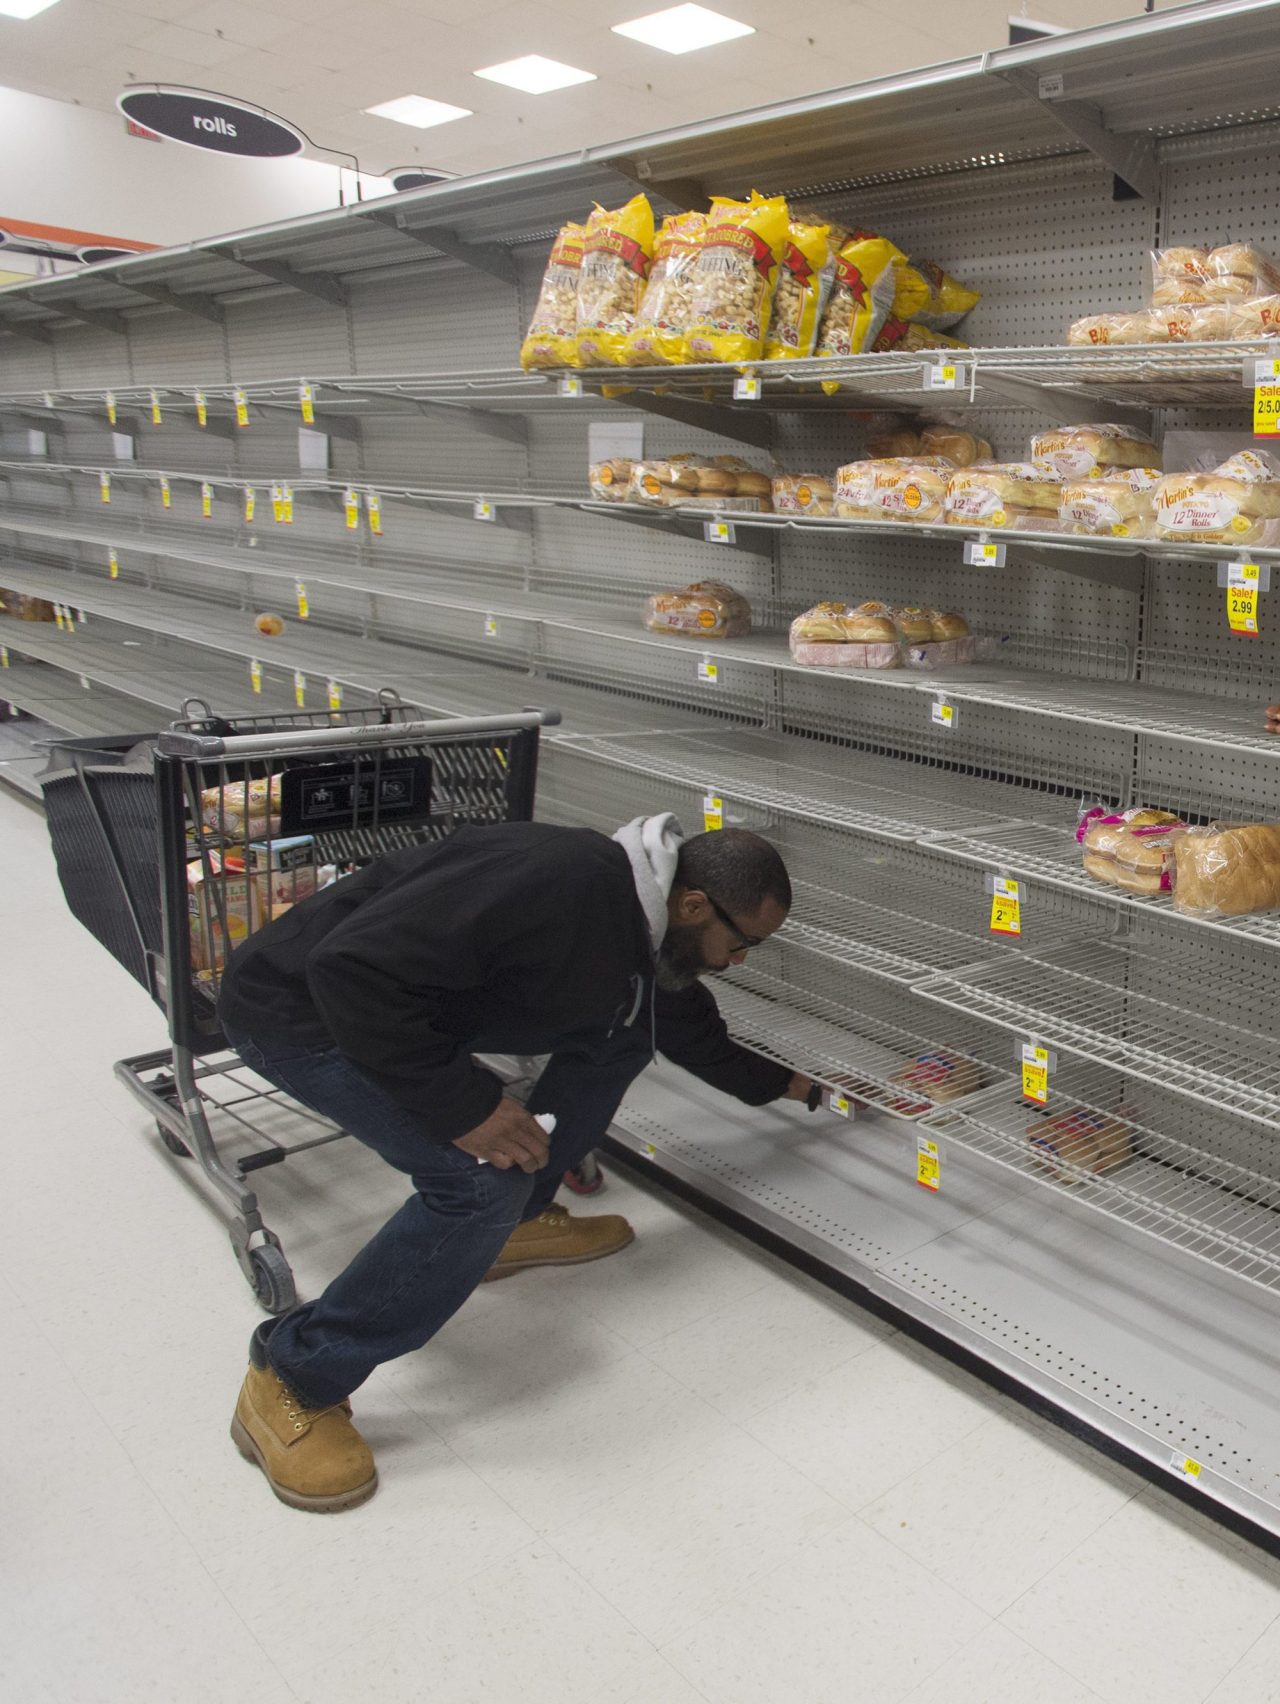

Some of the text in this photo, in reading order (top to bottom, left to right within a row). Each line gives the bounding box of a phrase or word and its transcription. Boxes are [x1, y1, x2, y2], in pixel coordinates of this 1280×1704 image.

[193, 115, 238, 137] rolls
[1035, 440, 1066, 457] Martin's
[952, 499, 965, 510] 12
[1157, 485, 1195, 511] Martin's
[1071, 509, 1083, 520] 12
[1173, 509, 1220, 525] 12 Dinner
[1191, 518, 1211, 528] Rolls
[1231, 586, 1254, 600] Sale!
[1232, 599, 1253, 615] 2.99
[350, 722, 425, 736] Thank You
